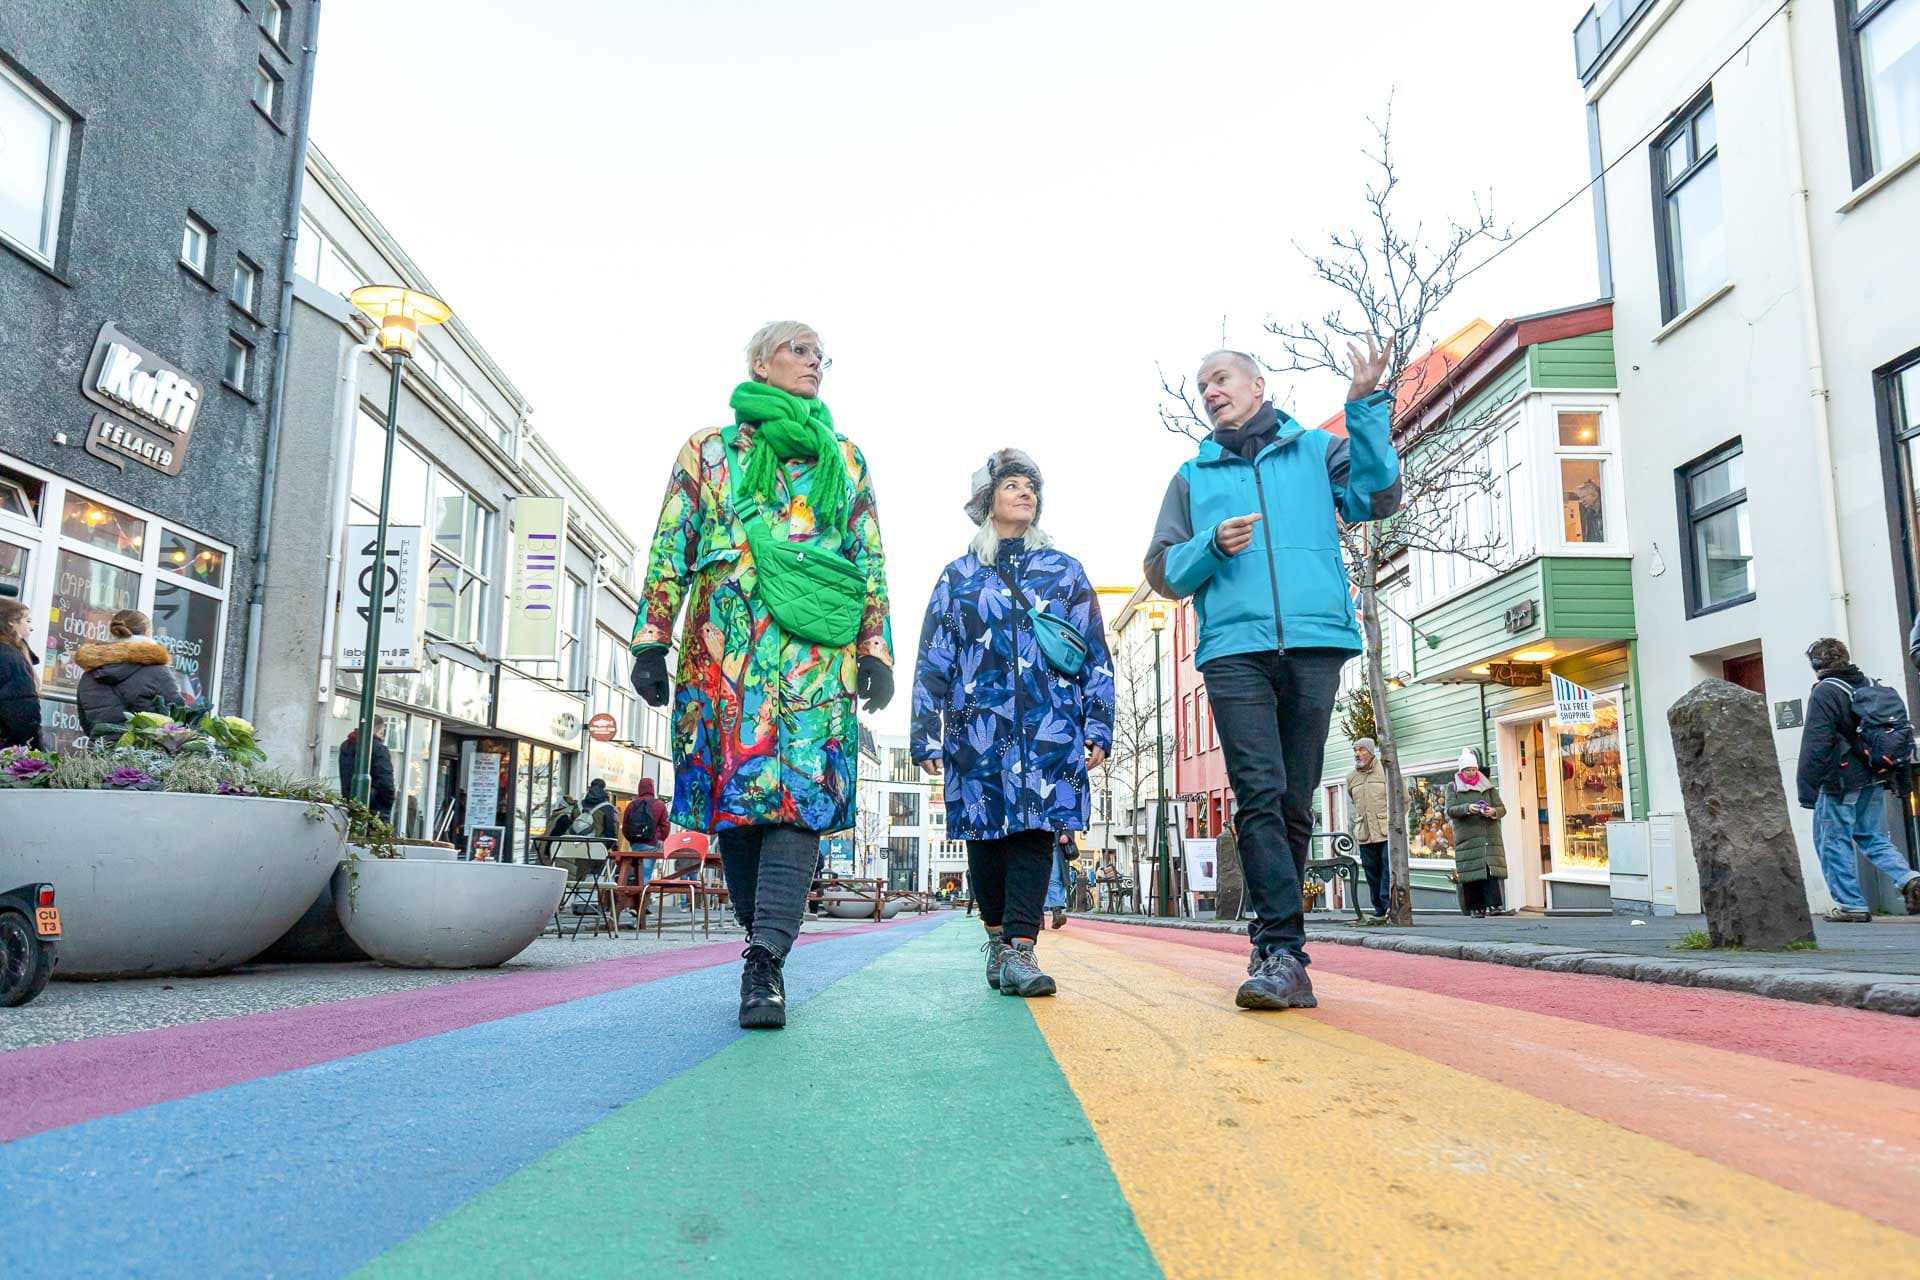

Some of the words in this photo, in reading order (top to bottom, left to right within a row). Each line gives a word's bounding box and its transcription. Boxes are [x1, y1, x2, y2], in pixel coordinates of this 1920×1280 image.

[96, 342, 199, 434] Kaffi
[100, 421, 173, 467] FÉLAGIÐ
[524, 534, 557, 621] BINGO
[1560, 702, 1571, 711] TAX
[1573, 702, 1589, 711] FREE
[1560, 711, 1591, 720] SHOPPING
[39, 910, 57, 920] CU
[41, 922, 57, 932] T3
